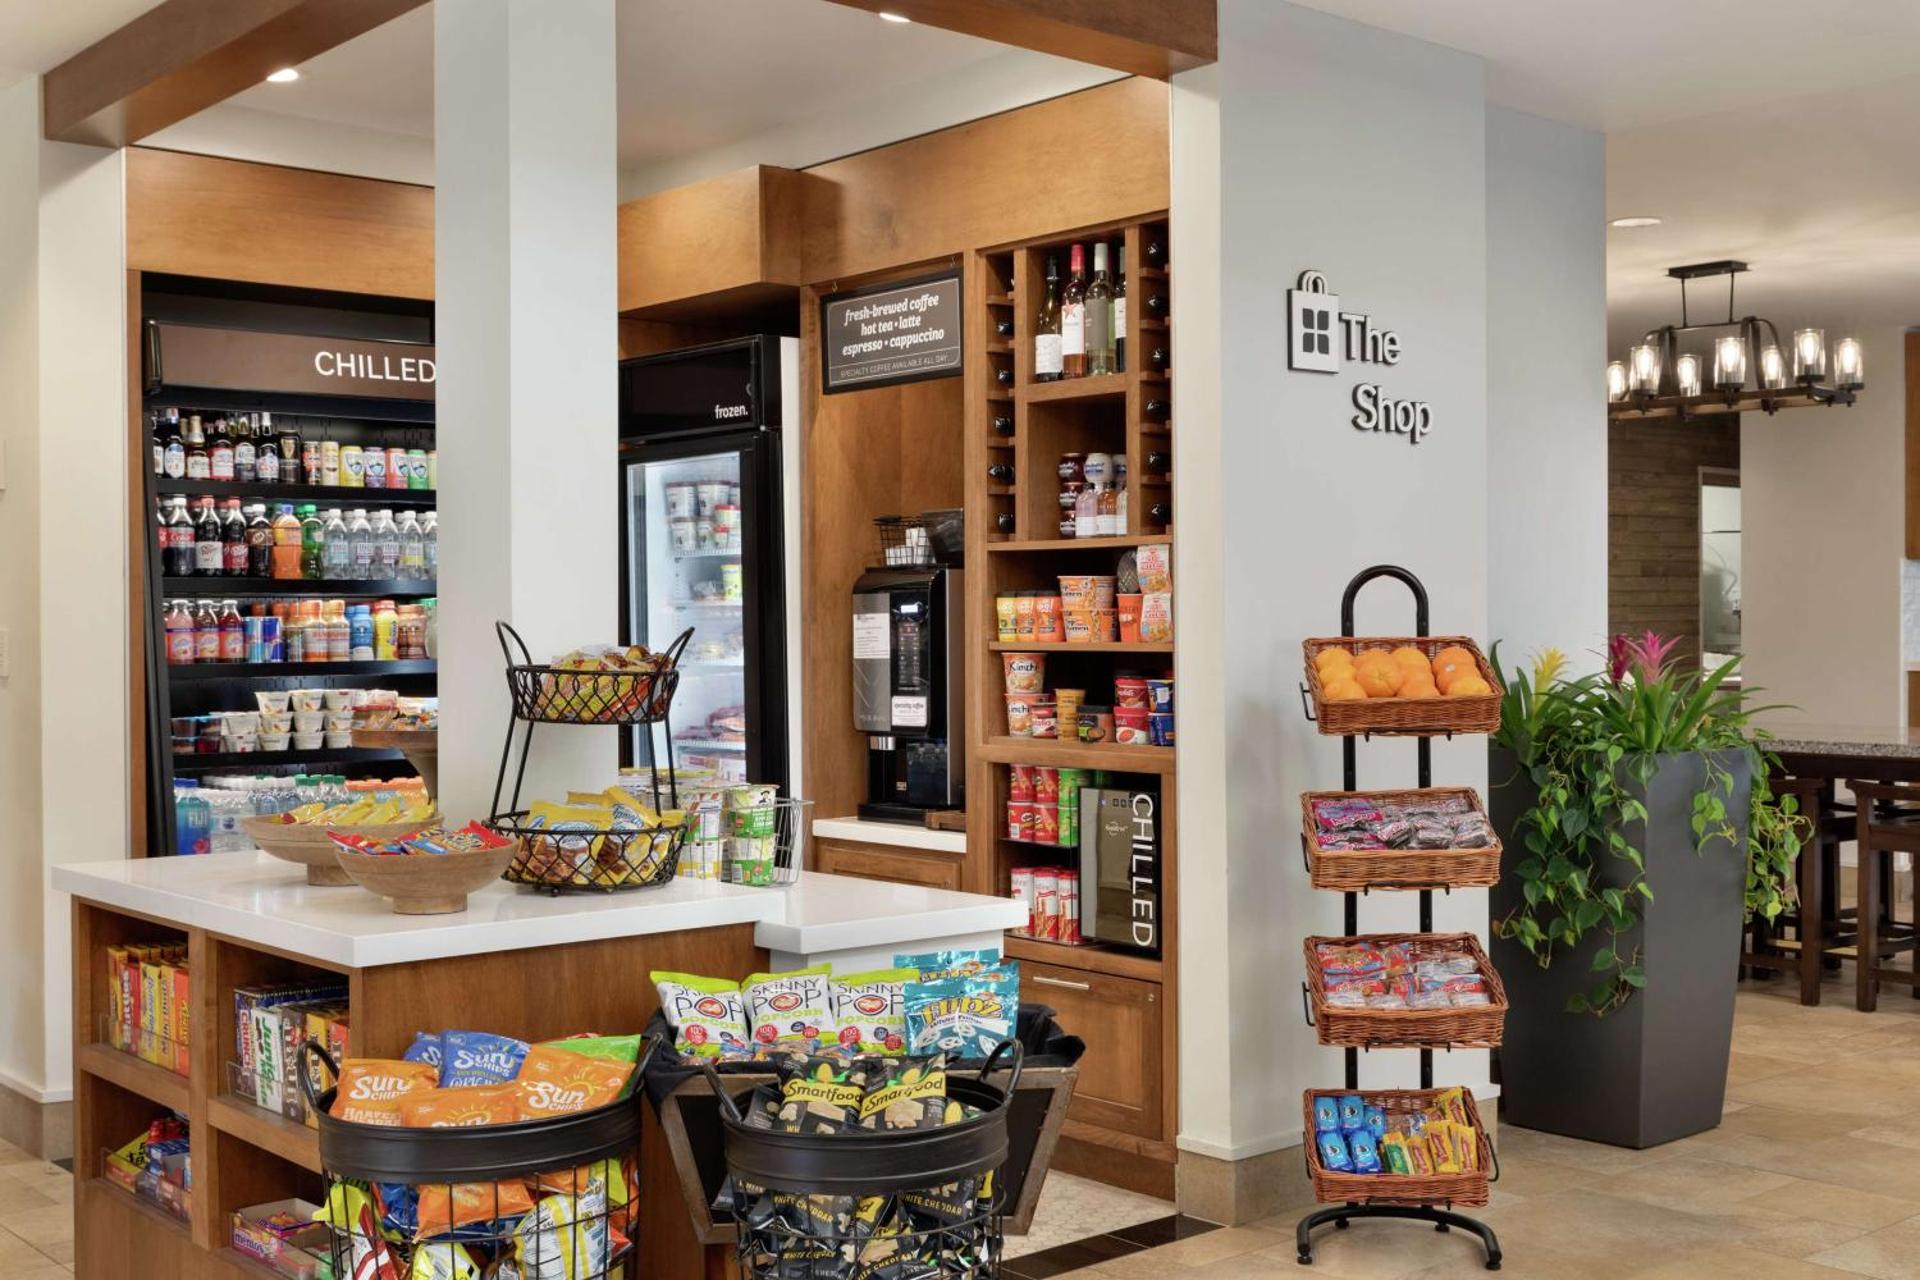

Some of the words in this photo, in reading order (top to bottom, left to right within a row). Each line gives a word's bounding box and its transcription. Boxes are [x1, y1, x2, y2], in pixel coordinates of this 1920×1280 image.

[844, 299, 908, 327] fresh-brewed
[909, 294, 939, 312] coffee
[861, 321, 877, 336] hot
[878, 319, 893, 332] tea
[899, 314, 921, 328] latte
[1339, 312, 1401, 364] The
[842, 340, 883, 358] espresso
[889, 328, 944, 350] cappuccino
[314, 351, 436, 383] CHILLED
[840, 366, 869, 377] SPECIALTY
[870, 362, 891, 373] COFFEE
[891, 357, 923, 371] AVAILABLE
[924, 356, 934, 366] ALL
[935, 354, 948, 364] DAY
[715, 404, 748, 419] frozen.
[1352, 383, 1432, 443] Shop
[1132, 794, 1153, 946] CHILLED
[752, 978, 820, 996] SKINNY
[675, 996, 744, 1021] POP
[752, 989, 822, 1016] POP
[528, 1081, 586, 1108] Sun
[786, 1081, 864, 1104] Smartfood
